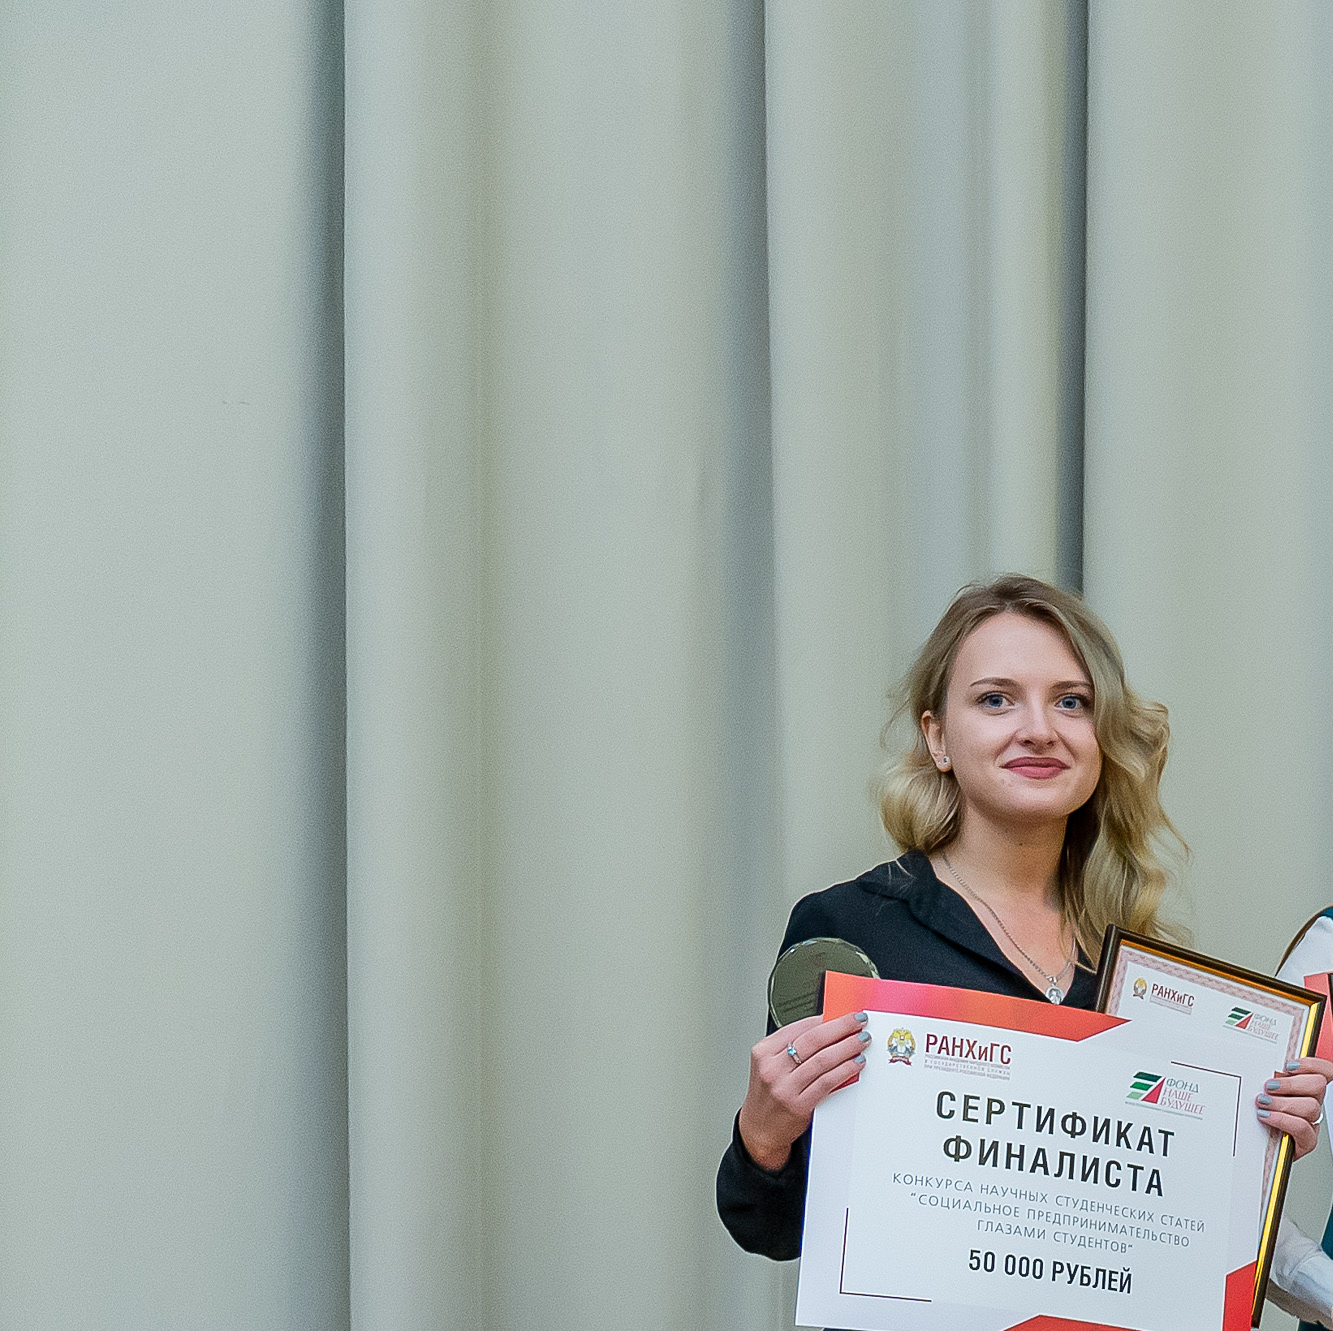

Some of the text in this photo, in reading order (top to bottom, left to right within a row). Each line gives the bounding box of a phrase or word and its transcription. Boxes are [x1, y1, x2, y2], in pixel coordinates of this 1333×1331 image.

[1151, 983, 1195, 1007] РАНХиГС
[925, 1033, 1012, 1065] РАНХиГС
[1162, 1088, 1193, 1101] НАШЕ
[1166, 1078, 1199, 1093] ФОНД
[1160, 1098, 1205, 1115] БУДУЩЕЕ
[936, 1091, 1175, 1157] СЕРТИФИКАТ
[943, 1135, 1164, 1197] ФИНАЛИСТА
[893, 1172, 1205, 1233] КОНКУРСА НАУЧНЫХ СТУДЕНЧЕСКИХ СТАТЕЙ
[977, 1219, 1047, 1240] ГЛАЗАМИ
[1027, 1208, 1190, 1247] ПРЕДПРИНИМАТЕЛЬСТВО
[968, 1249, 1132, 1294] 50 000 РУБЛЕЙ
